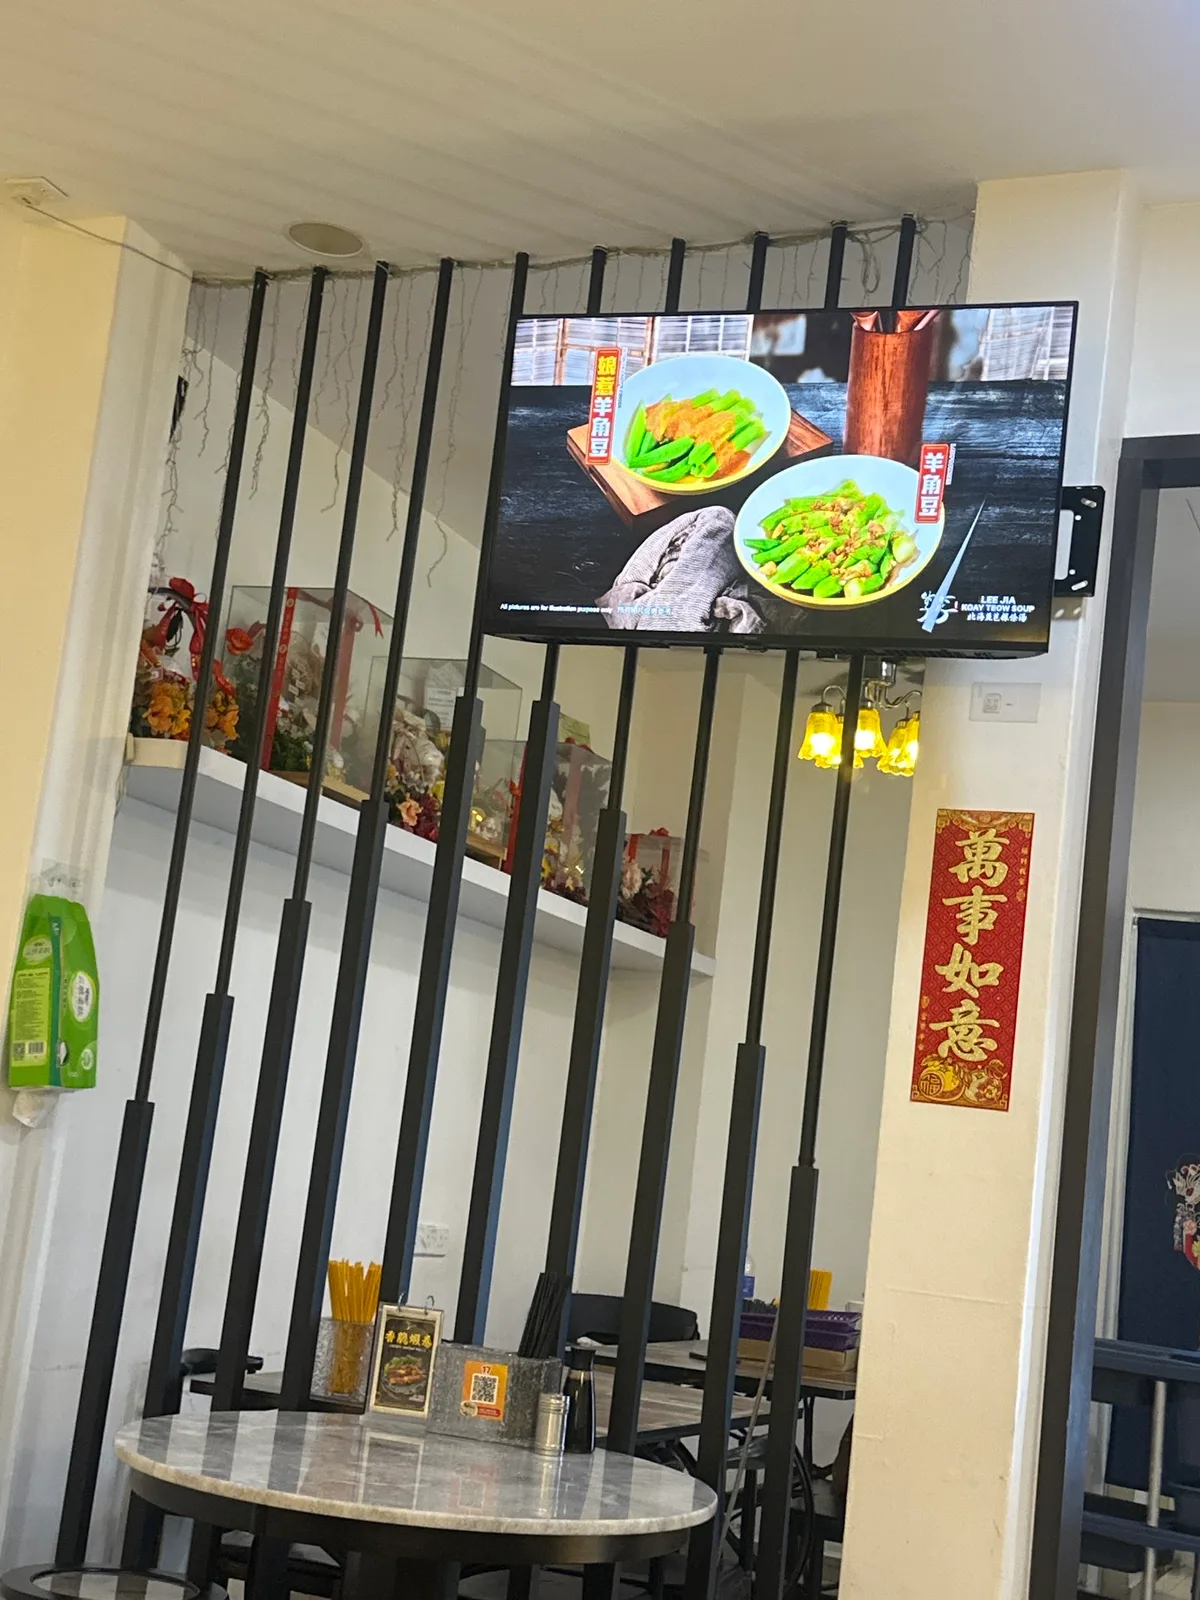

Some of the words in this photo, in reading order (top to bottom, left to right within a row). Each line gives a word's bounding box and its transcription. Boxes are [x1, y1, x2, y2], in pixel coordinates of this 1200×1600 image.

[589, 355, 617, 457] 娘惹羊角豆
[918, 452, 945, 517] 羊角豆
[981, 595, 998, 604] LEE
[999, 595, 1016, 605] JIA
[508, 603, 530, 611] pictures
[961, 603, 985, 612] KOAY
[986, 604, 1010, 613] TEOW
[1011, 604, 1036, 613] SOUP
[929, 828, 1009, 1062] 萬事如意
[482, 1365, 492, 1374] 17
